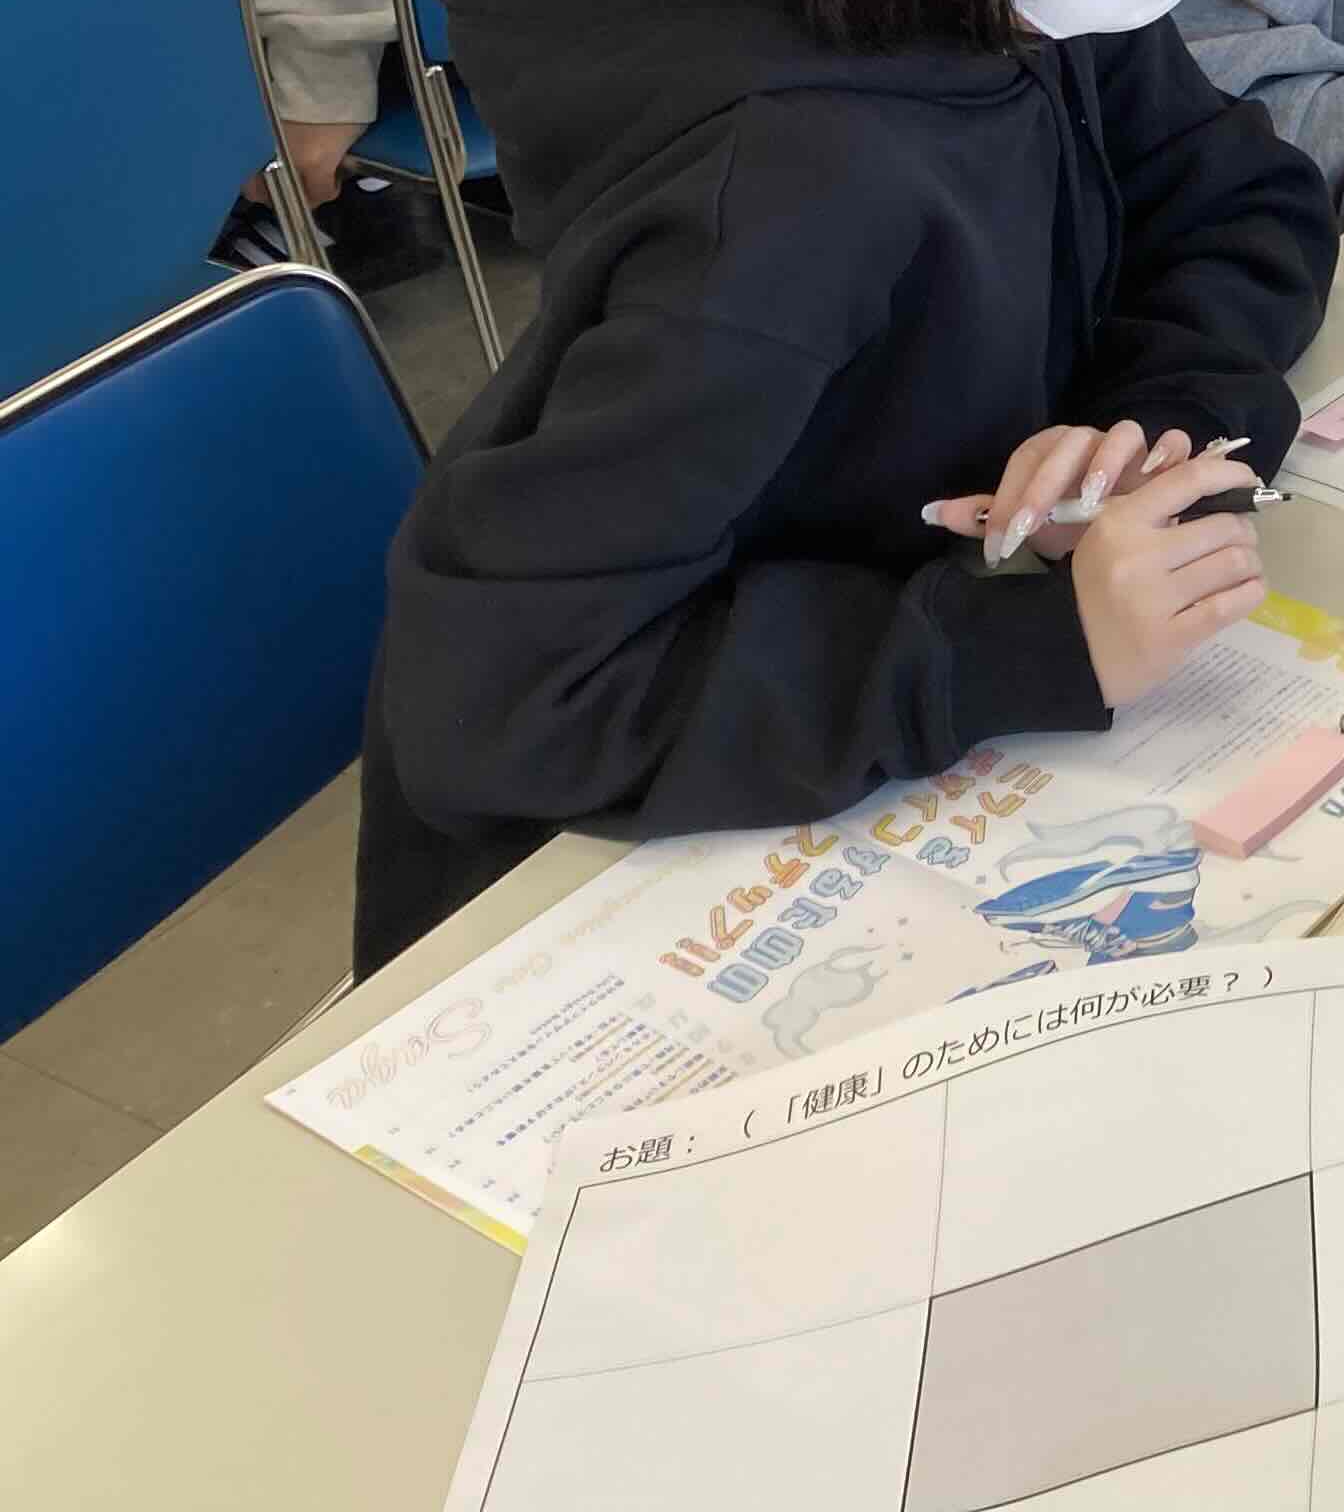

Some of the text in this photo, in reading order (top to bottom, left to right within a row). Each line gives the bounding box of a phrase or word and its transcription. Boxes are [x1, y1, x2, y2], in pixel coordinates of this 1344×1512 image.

[744, 965, 1273, 1139] （「健康」のためには何が必要？）
